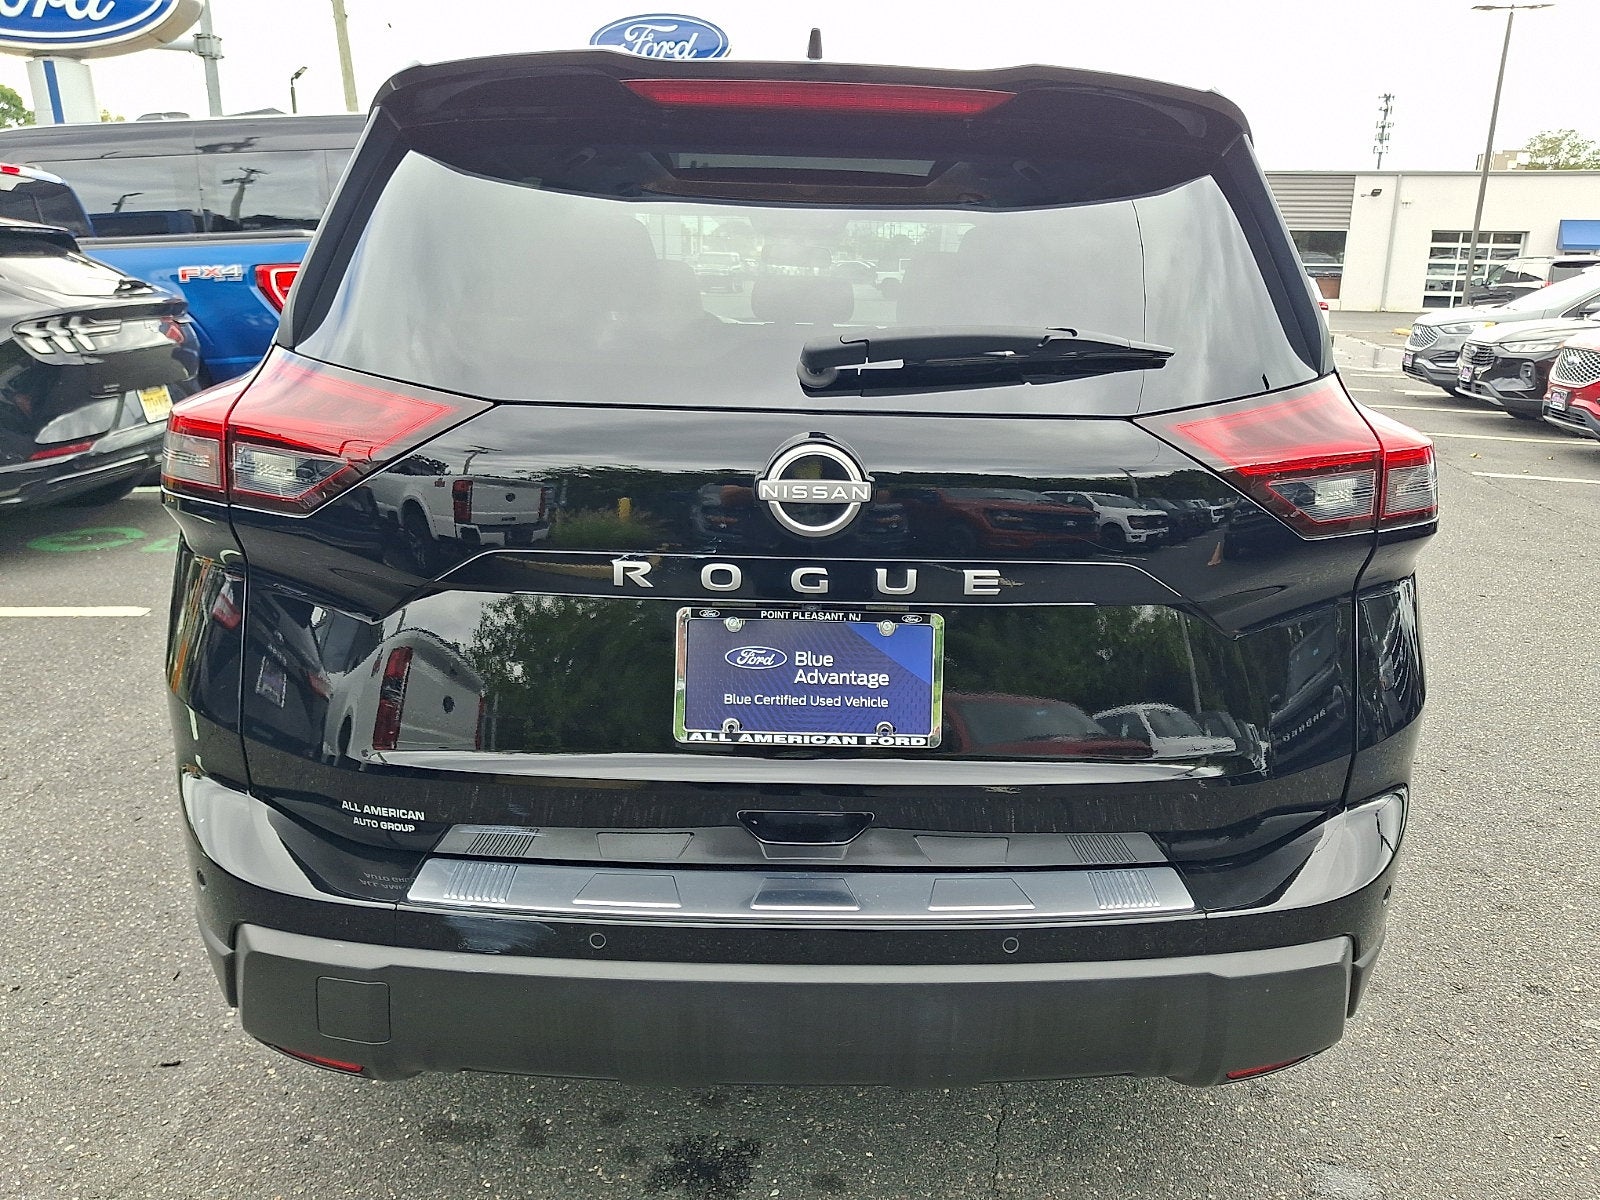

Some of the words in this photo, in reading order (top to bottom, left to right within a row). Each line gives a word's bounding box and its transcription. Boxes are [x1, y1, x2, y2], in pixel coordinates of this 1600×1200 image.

[0, 0, 116, 21] ord
[178, 264, 243, 284] FX4
[761, 484, 869, 500] NISSAN
[612, 560, 1001, 596] ROGUE
[760, 610, 790, 620] POINT
[792, 611, 847, 622] PLEASANT,
[848, 613, 862, 622] NJ
[737, 649, 776, 666] Ford
[795, 651, 834, 667] Blue
[793, 669, 890, 689] Advantage
[724, 694, 752, 705] Blue
[754, 694, 807, 706] Certified
[809, 695, 842, 707] Used
[844, 696, 889, 708] Vehicle
[689, 733, 733, 742] ALL
[736, 733, 857, 745] AMERICAN
[865, 736, 927, 746] FORD
[341, 800, 361, 812] ALL
[363, 804, 425, 820] AMERICAN
[353, 816, 379, 828] AUTO
[380, 821, 416, 832] GROUP
